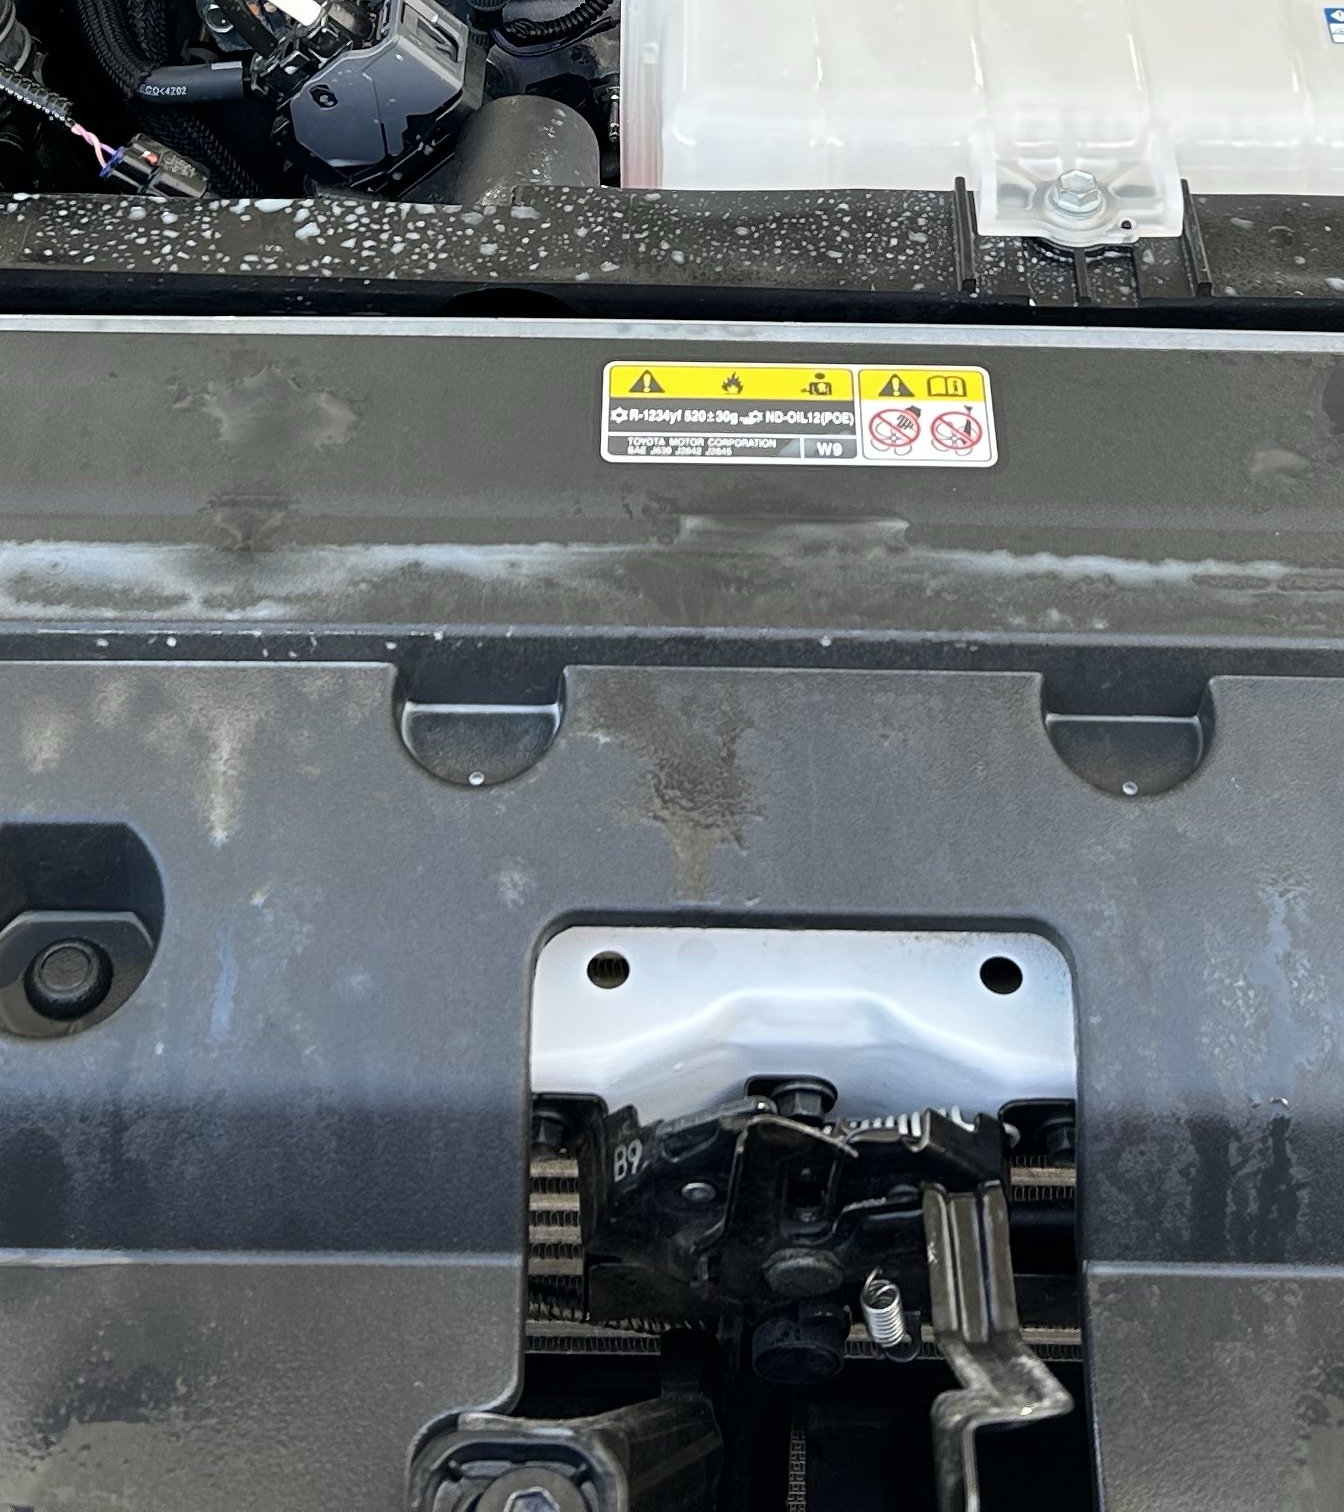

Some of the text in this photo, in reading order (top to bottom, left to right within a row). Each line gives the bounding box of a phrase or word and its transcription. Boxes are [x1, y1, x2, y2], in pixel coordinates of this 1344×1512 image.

[629, 408, 682, 425] R-1234yf
[765, 410, 855, 426] ND-OIL12(POE)
[627, 437, 777, 449] TOYOTA MOTOR CORPORATION
[816, 441, 844, 457] W9
